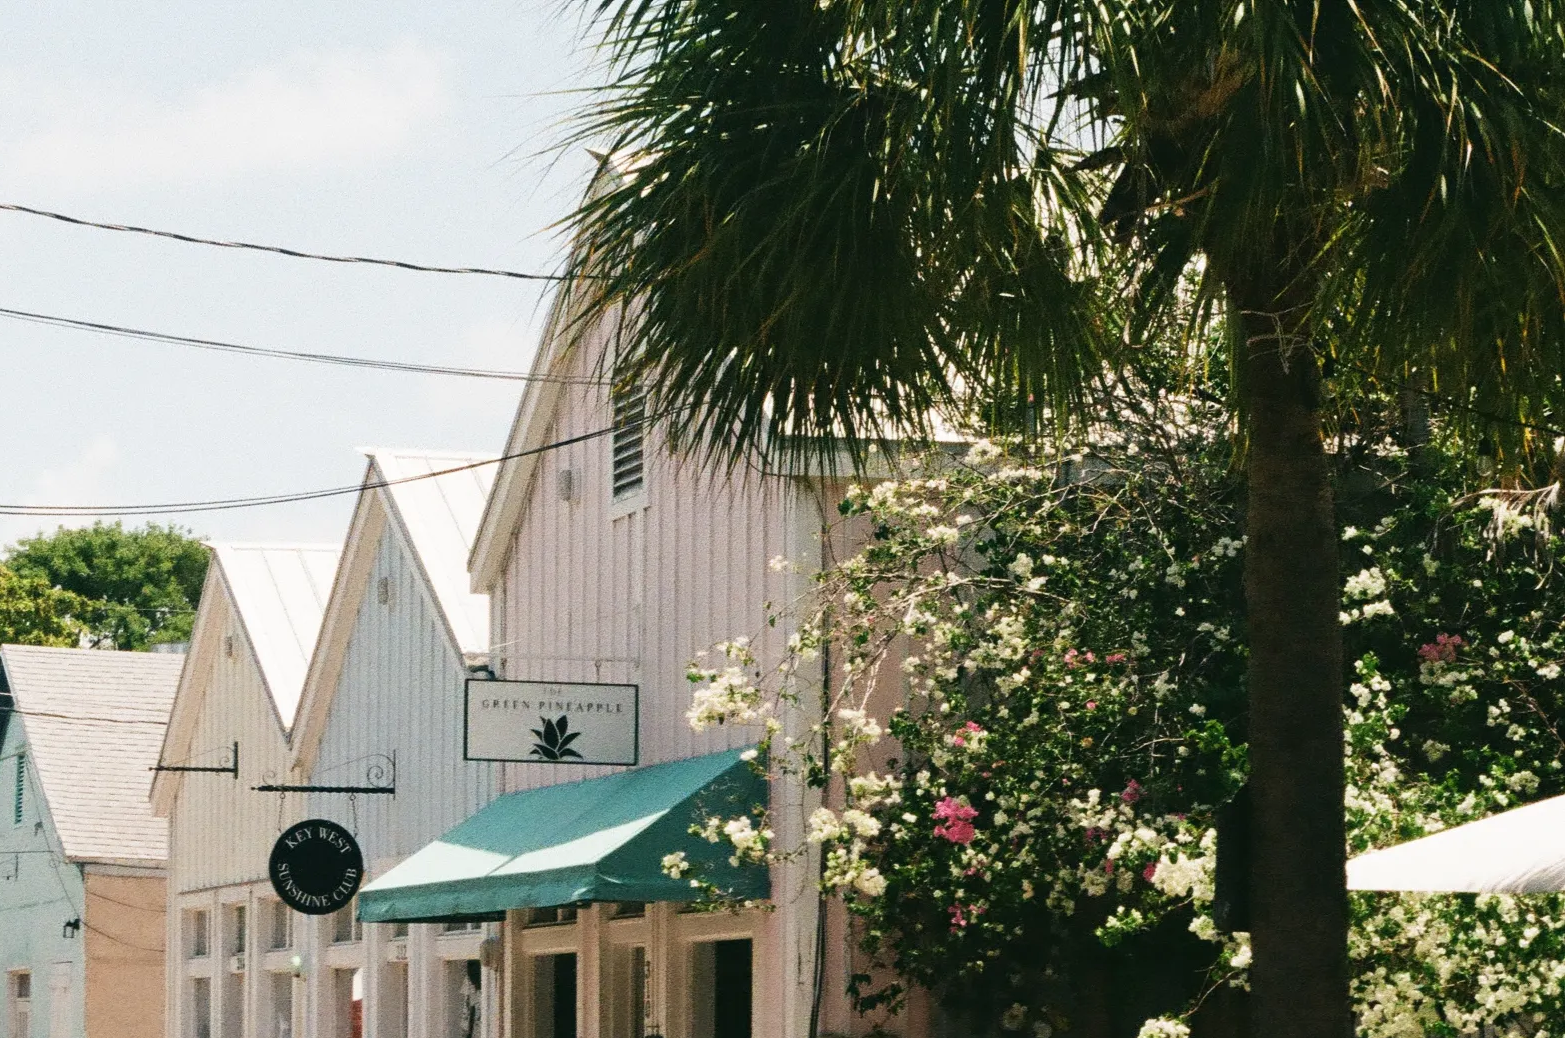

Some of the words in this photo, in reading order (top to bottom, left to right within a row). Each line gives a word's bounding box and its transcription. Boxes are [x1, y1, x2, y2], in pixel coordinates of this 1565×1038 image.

[481, 699, 531, 710] GREEN
[538, 701, 623, 713] PINEAPPLE
[285, 827, 314, 849] KEY
[319, 826, 352, 855] WEST
[277, 863, 331, 907] SUNSHINE
[333, 868, 358, 901] CLUB
